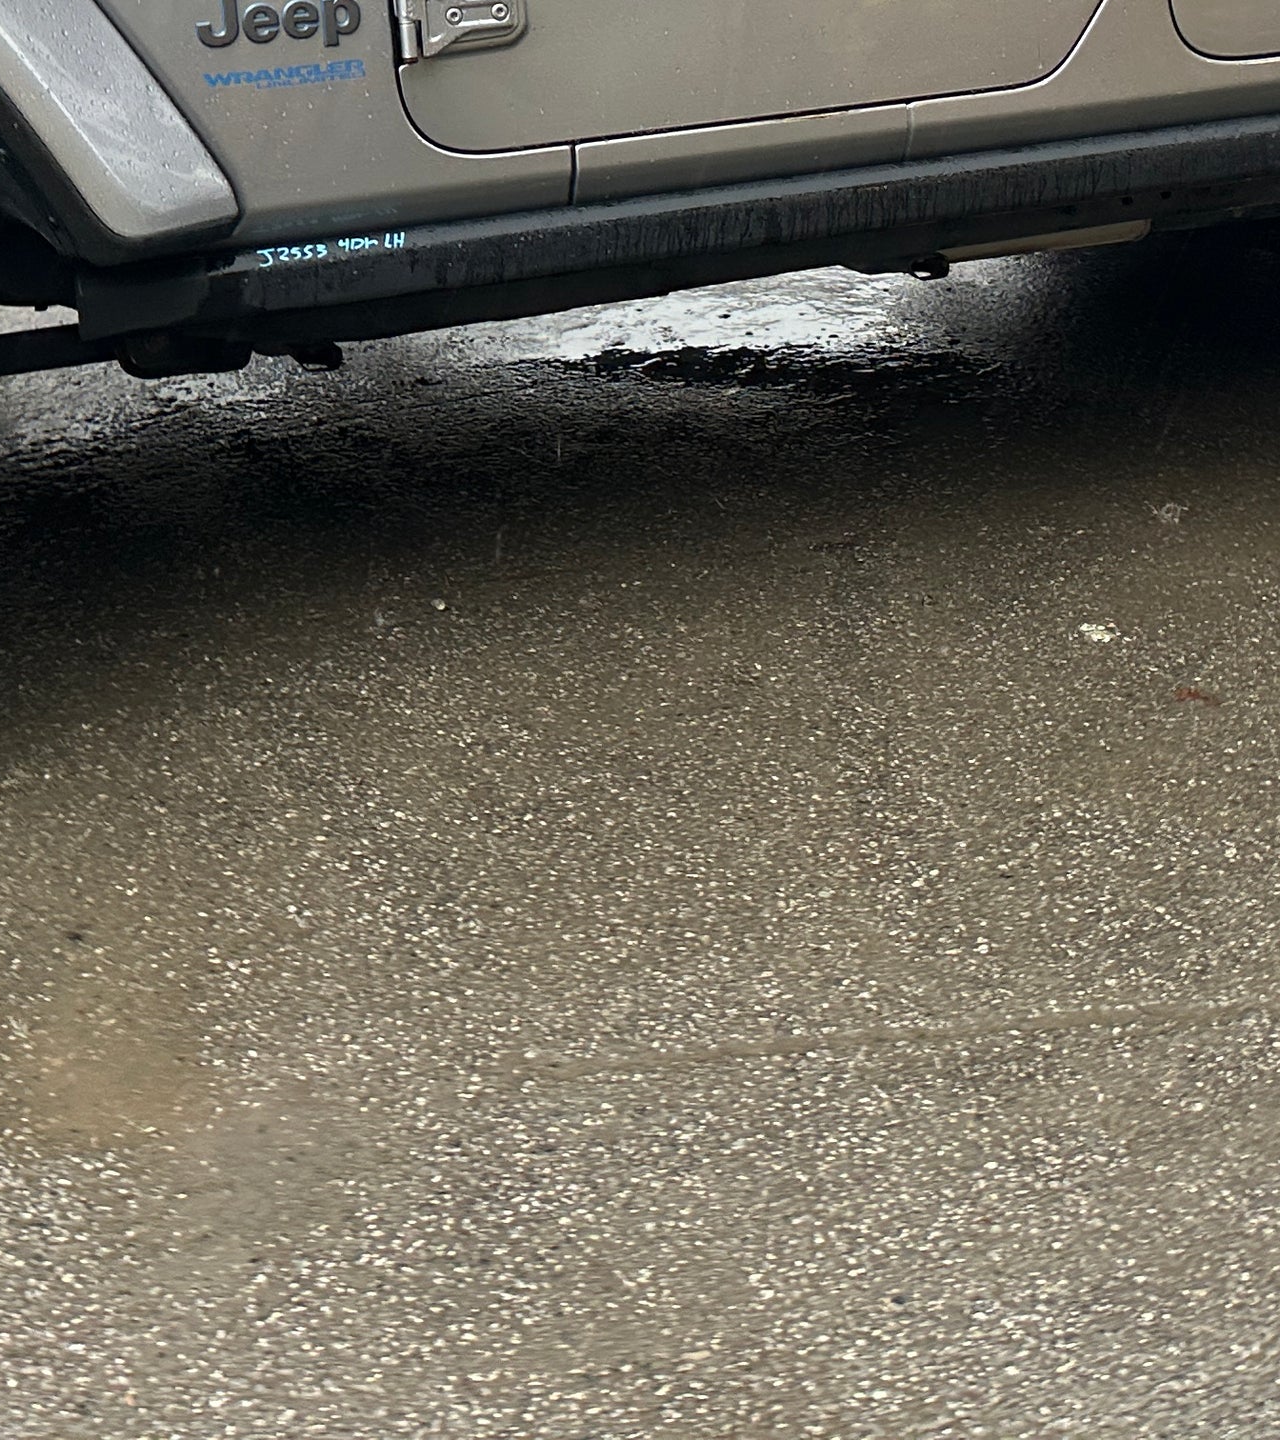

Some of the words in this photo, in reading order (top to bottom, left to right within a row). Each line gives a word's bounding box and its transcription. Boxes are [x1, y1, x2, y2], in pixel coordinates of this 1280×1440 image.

[203, 59, 365, 87] WRANGLER
[257, 244, 328, 267] J2553
[384, 232, 405, 249] LH
